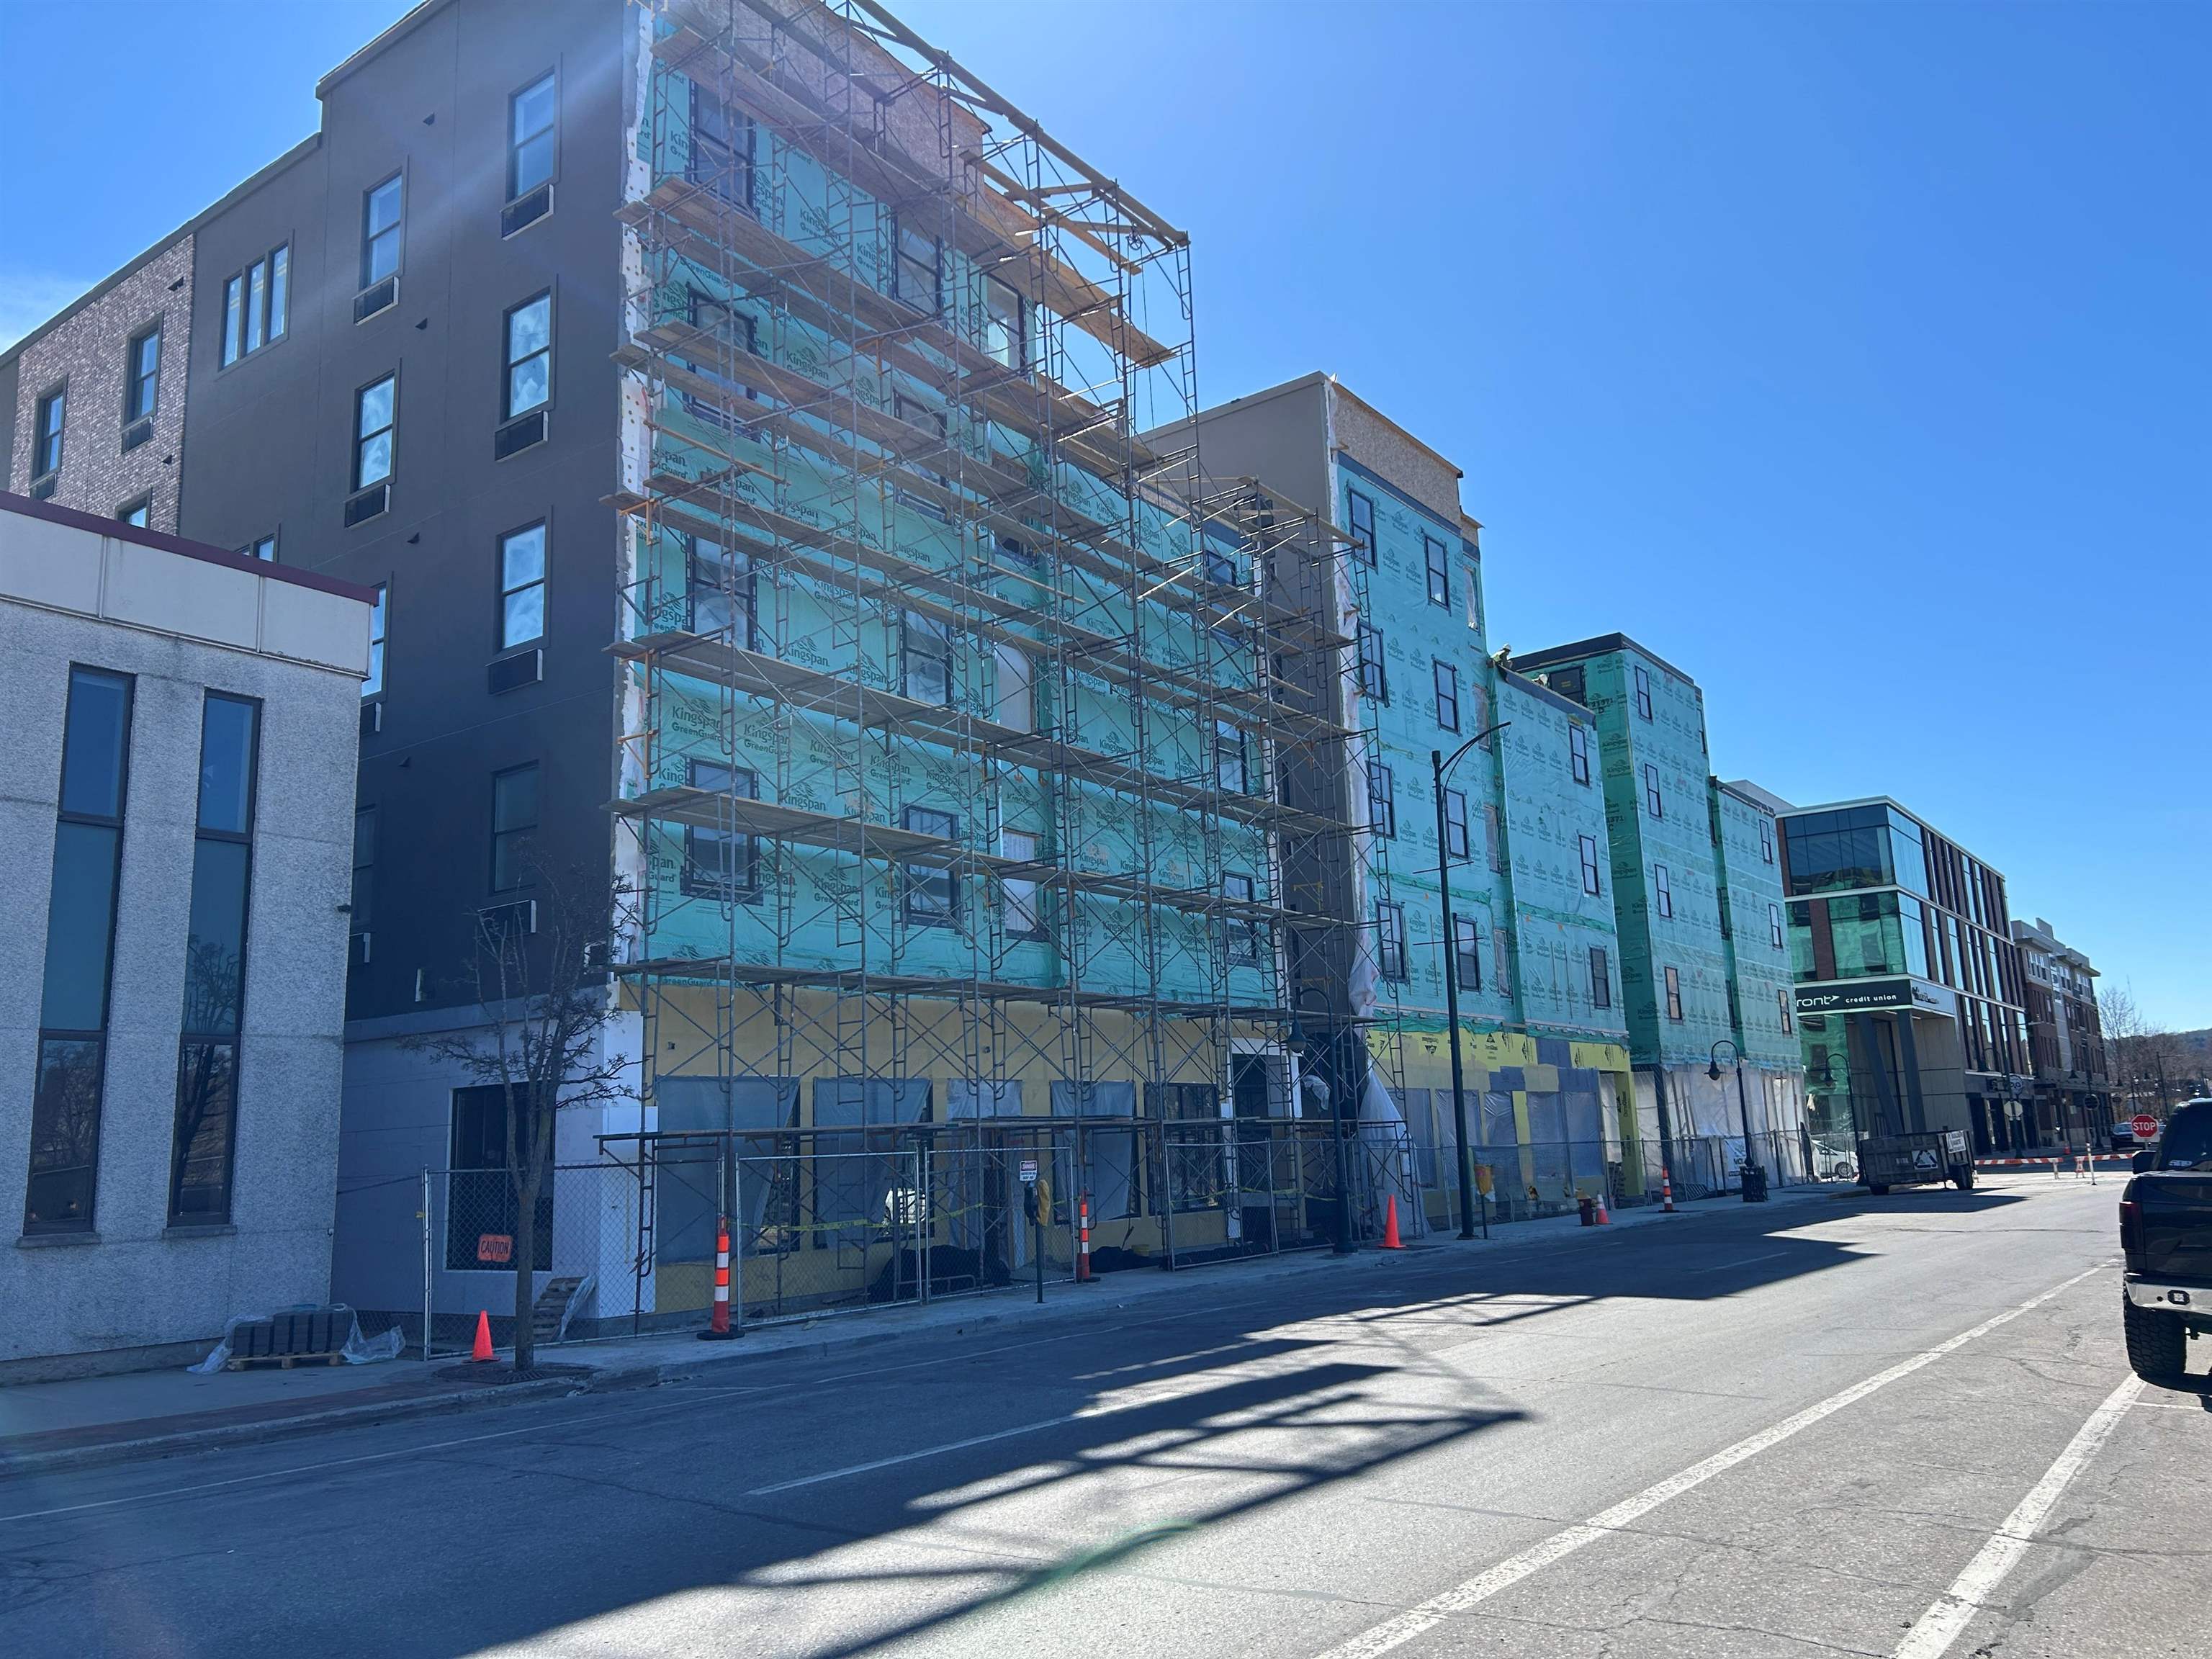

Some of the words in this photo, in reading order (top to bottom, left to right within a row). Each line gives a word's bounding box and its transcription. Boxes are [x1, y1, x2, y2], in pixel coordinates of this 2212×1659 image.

[786, 351, 829, 380] Kingspan
[2132, 1122, 2157, 1131] STOP
[480, 1240, 510, 1254] CAUTION
